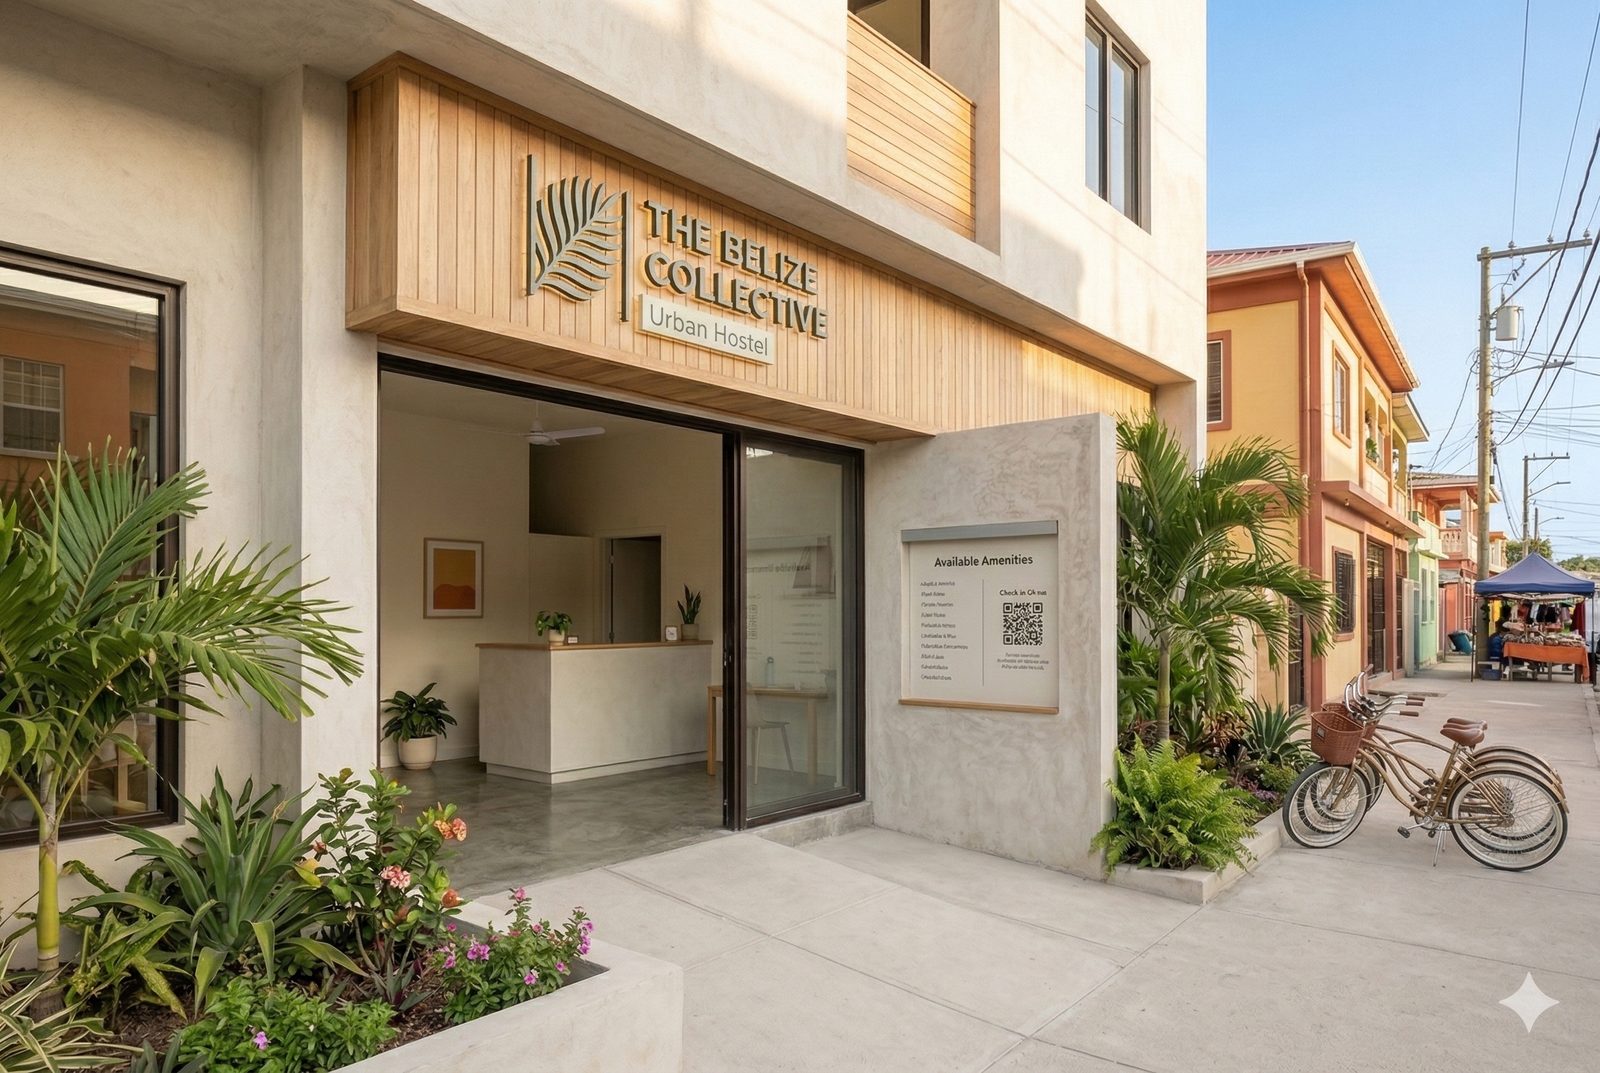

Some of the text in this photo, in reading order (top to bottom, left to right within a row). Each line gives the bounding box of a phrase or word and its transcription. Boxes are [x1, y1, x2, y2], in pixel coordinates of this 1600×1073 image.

[643, 200, 818, 295] THE BELIZE
[645, 252, 829, 339] COLLECTIVE
[649, 303, 768, 356] Urban Hostel
[934, 554, 1034, 568] Available Amenities
